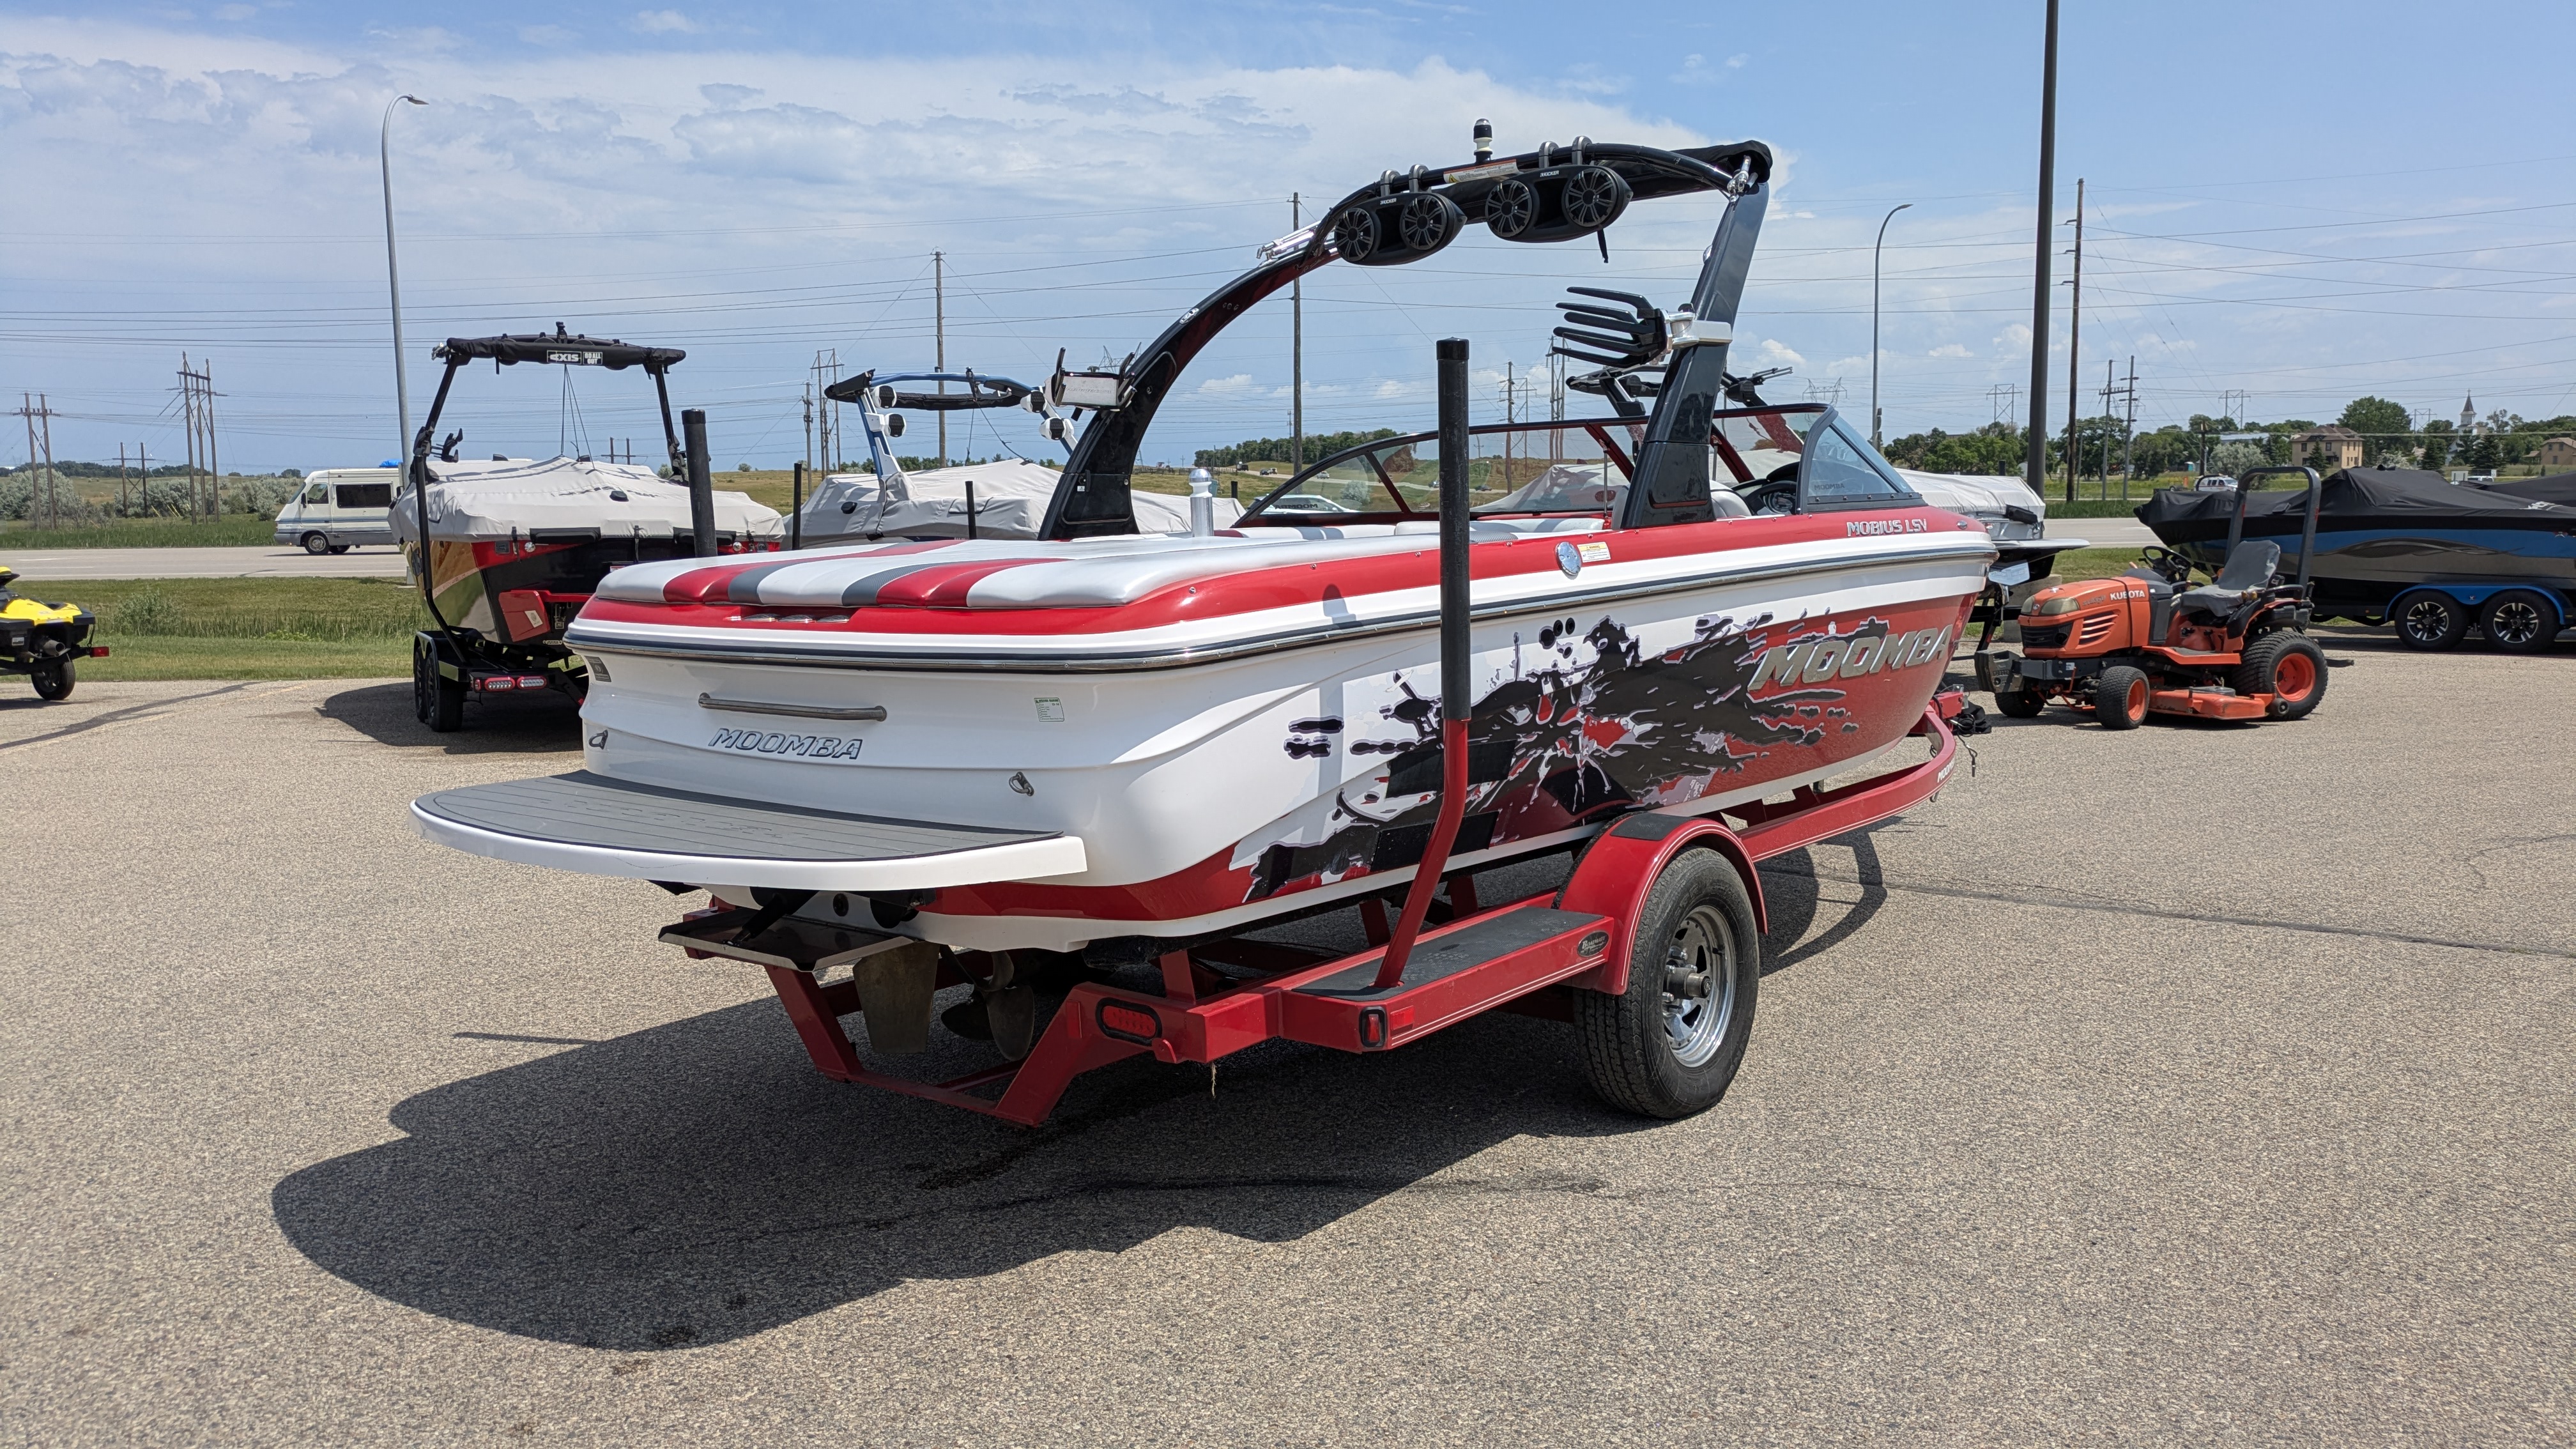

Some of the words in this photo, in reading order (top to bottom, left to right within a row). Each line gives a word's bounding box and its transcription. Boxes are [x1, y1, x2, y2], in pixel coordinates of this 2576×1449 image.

[549, 353, 579, 362] AXIS
[1814, 482, 1845, 491] MOOMBA
[1846, 519, 1903, 537] MOBIUS
[1905, 518, 1928, 533] LSV
[2110, 590, 2145, 601] KUBOTA
[1747, 624, 1953, 692] MOOMBA
[708, 727, 863, 760] MOOMBA
